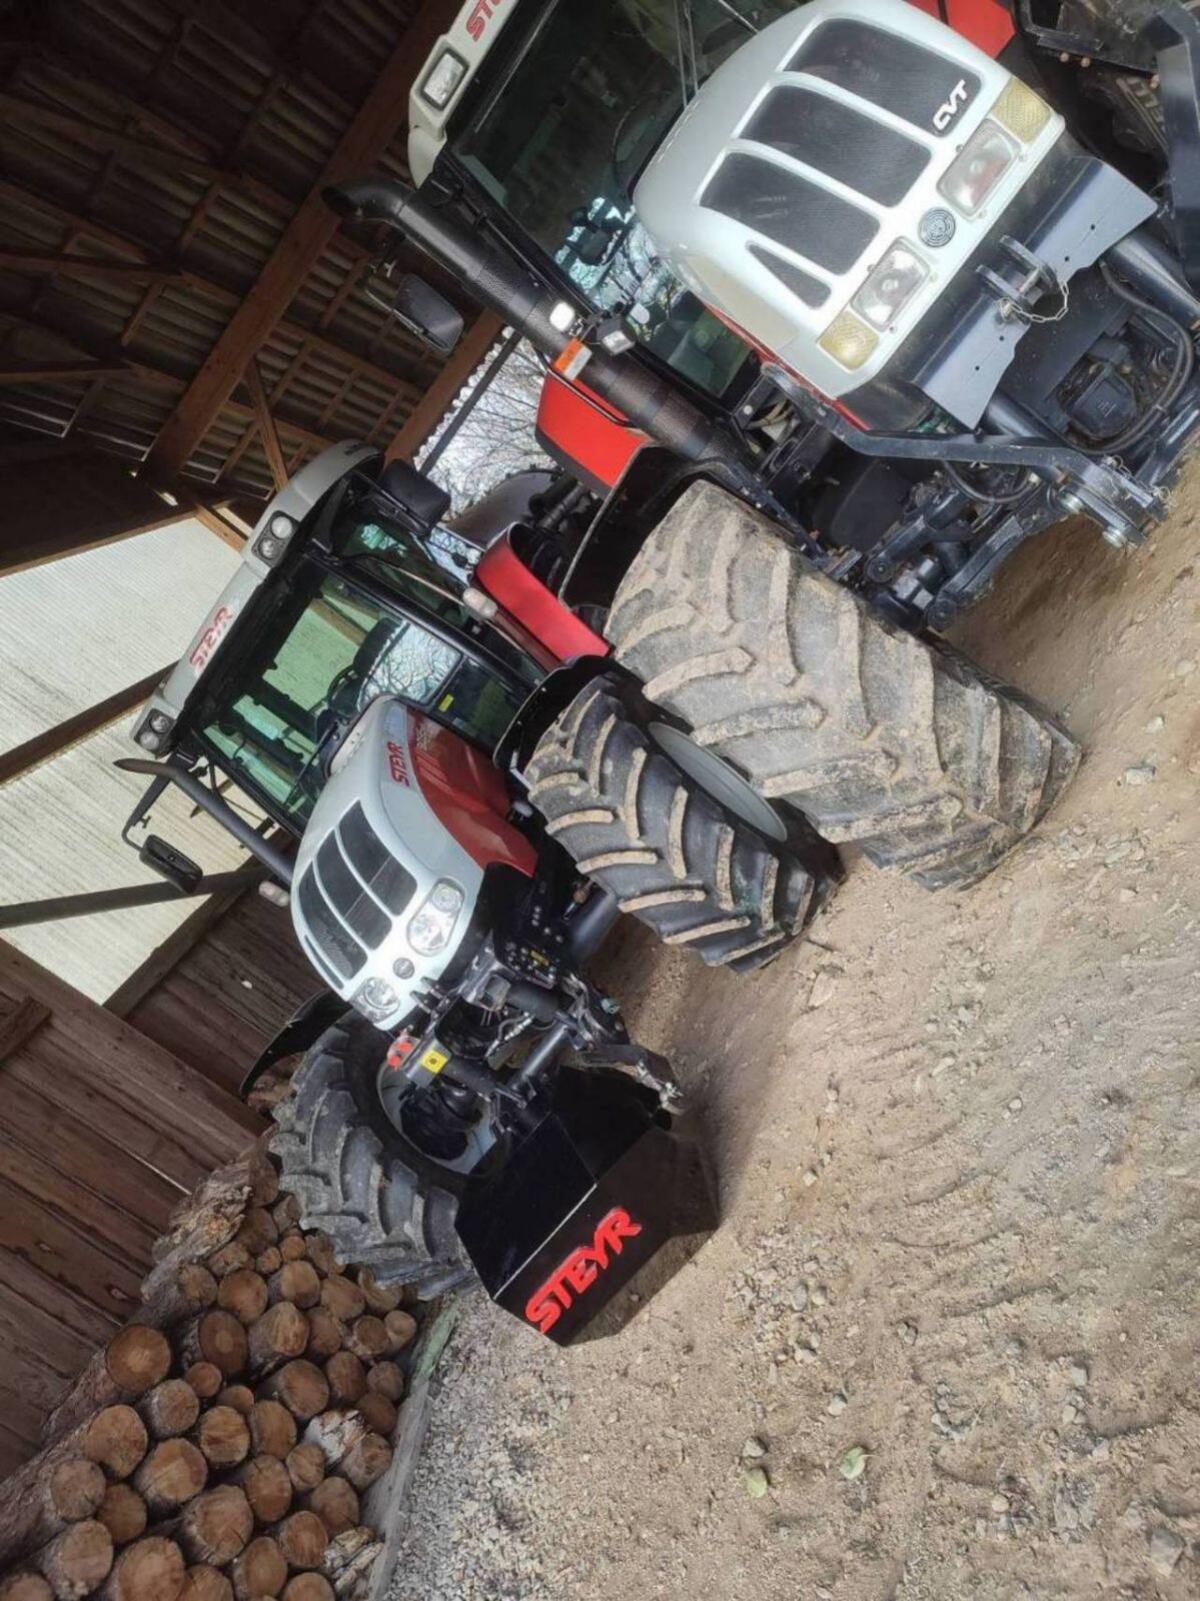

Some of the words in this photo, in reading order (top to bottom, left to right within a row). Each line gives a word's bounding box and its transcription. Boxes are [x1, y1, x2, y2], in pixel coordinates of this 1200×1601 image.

[466, 0, 501, 42] ST
[933, 79, 967, 130] CVT
[189, 606, 233, 671] STEYR
[387, 741, 410, 787] STEYR
[525, 1206, 642, 1334] STEYR
